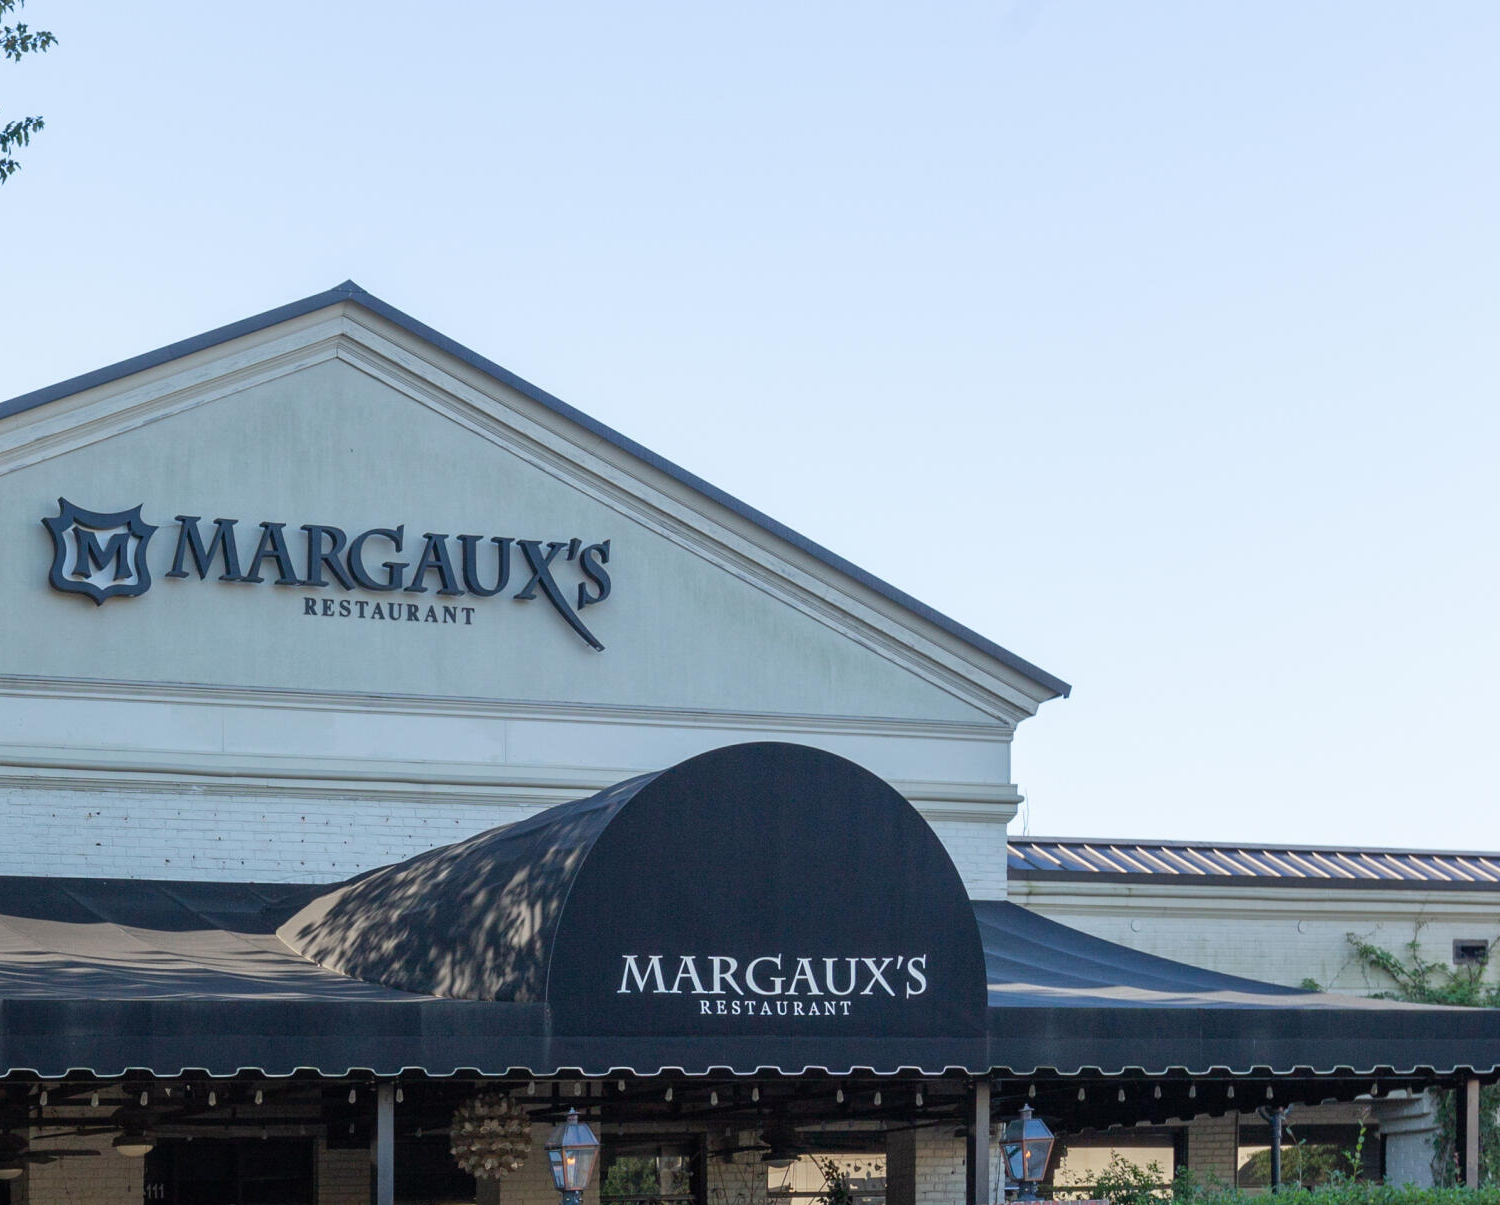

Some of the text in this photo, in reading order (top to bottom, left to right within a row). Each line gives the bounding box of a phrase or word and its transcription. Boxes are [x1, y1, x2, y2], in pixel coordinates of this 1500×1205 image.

[71, 525, 134, 582] M
[165, 514, 611, 652] MARGAUX'S
[303, 597, 476, 626] RESTAURANT
[616, 953, 928, 1000] MARGAUX'S
[700, 1000, 853, 1017] RESTAURANT
